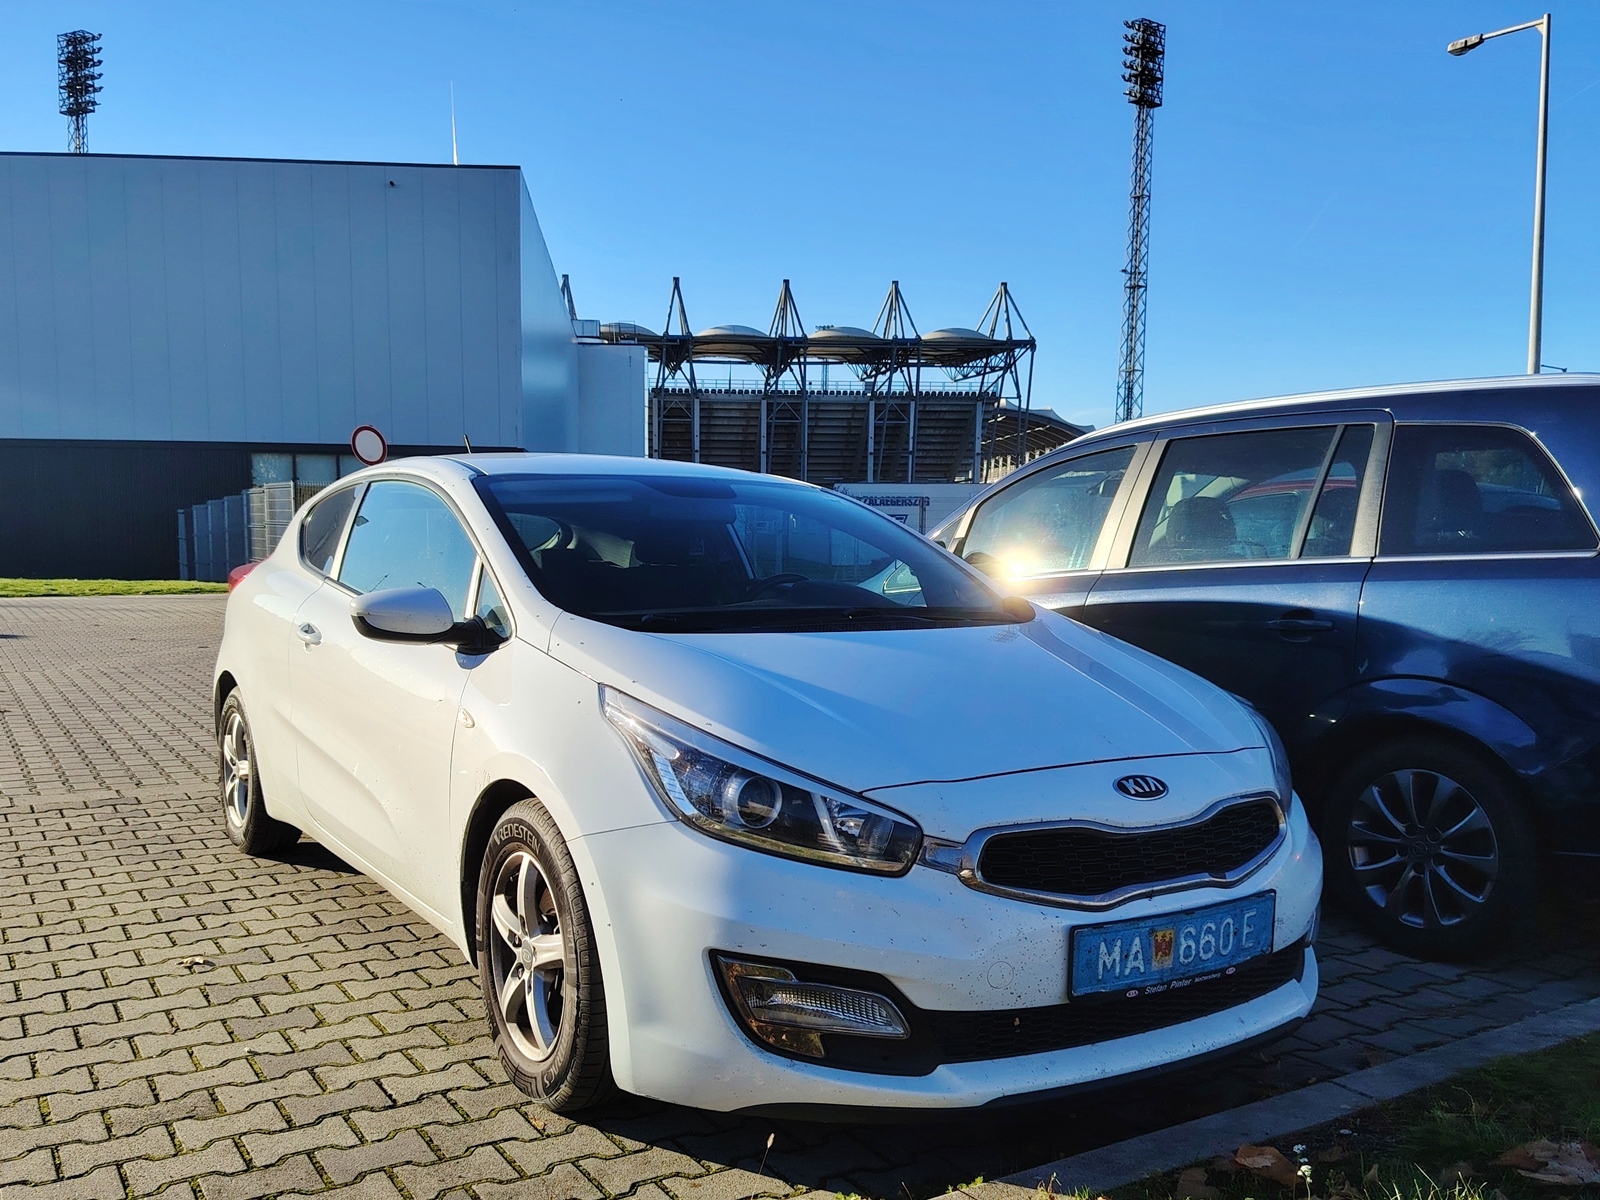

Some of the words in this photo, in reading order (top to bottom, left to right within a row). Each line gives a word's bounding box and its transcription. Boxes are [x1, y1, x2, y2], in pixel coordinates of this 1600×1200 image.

[1120, 776, 1164, 794] KIA
[493, 823, 541, 855] VREDESTEIN
[1098, 936, 1146, 979] MA
[1179, 917, 1235, 965] 660
[1242, 908, 1258, 948] E
[1145, 984, 1168, 995] Stefan
[1170, 978, 1193, 990] Pinter
